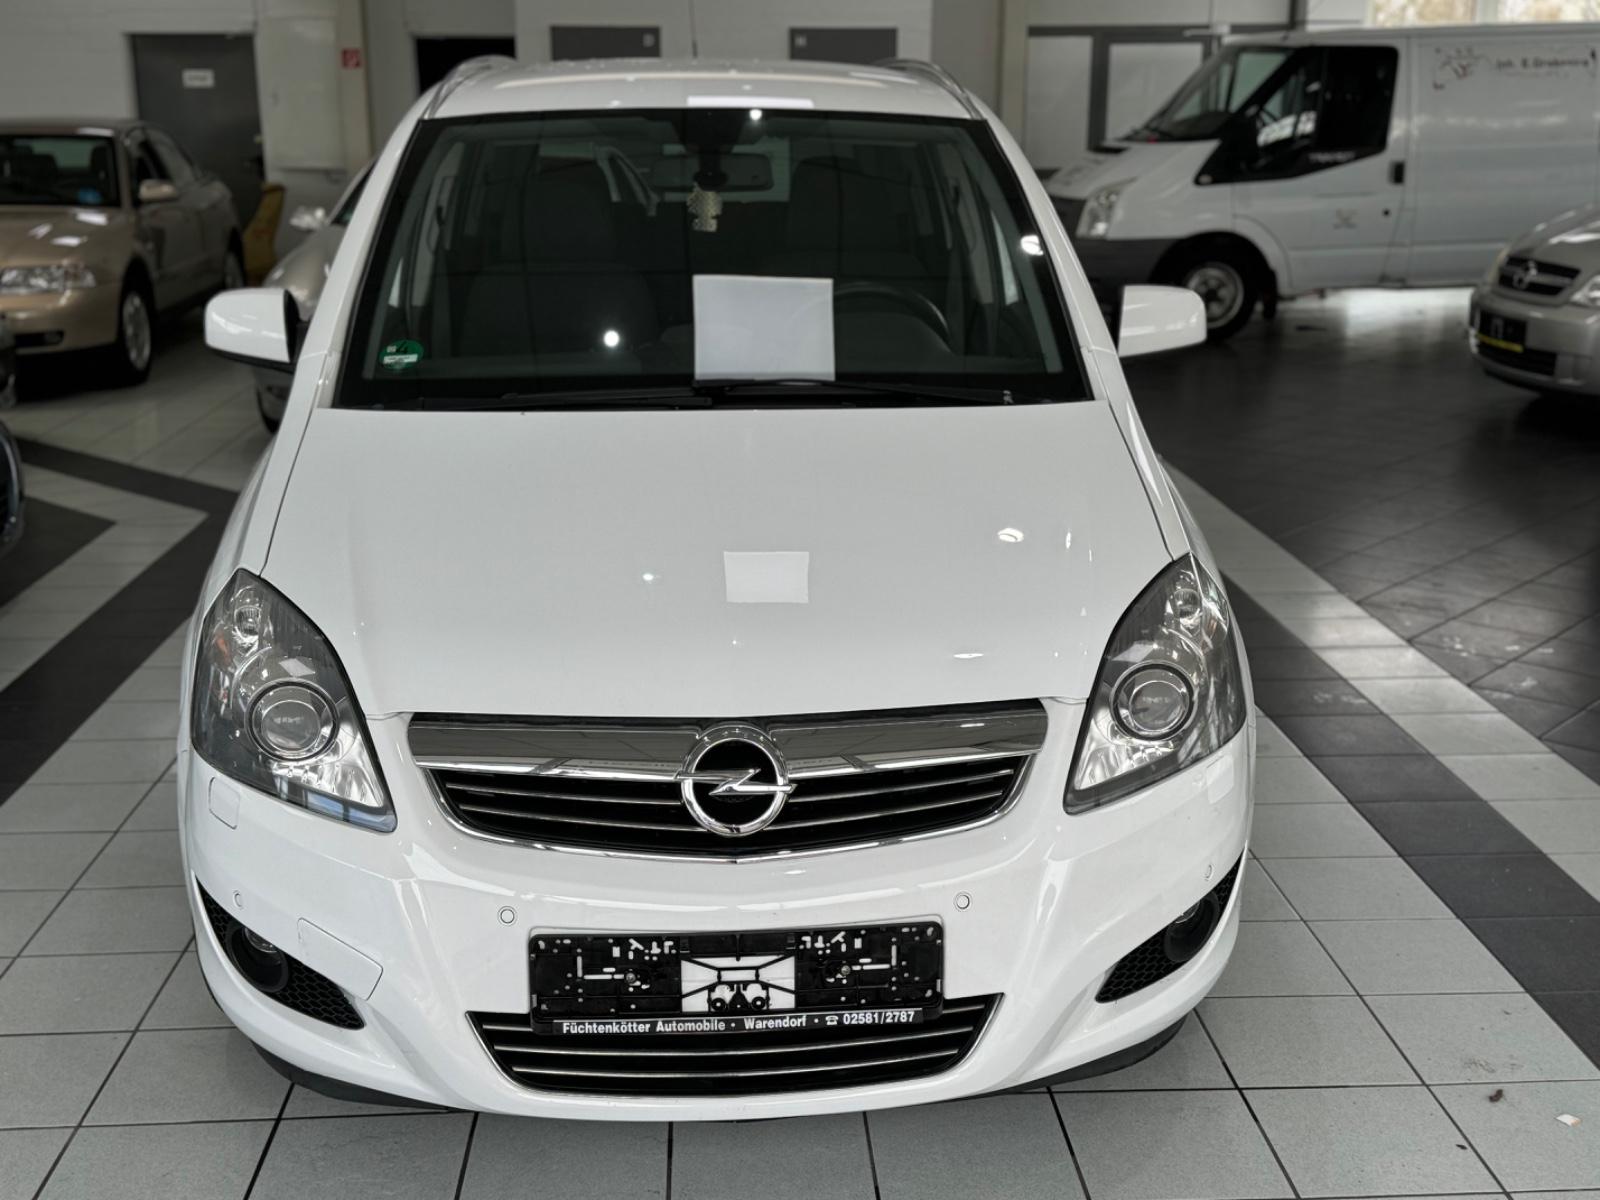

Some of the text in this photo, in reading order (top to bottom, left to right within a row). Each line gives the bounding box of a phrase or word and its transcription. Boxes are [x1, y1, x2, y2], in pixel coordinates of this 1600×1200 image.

[562, 1010, 915, 1034] Füchtenkötter Automobile Warendorf 02581/2787
